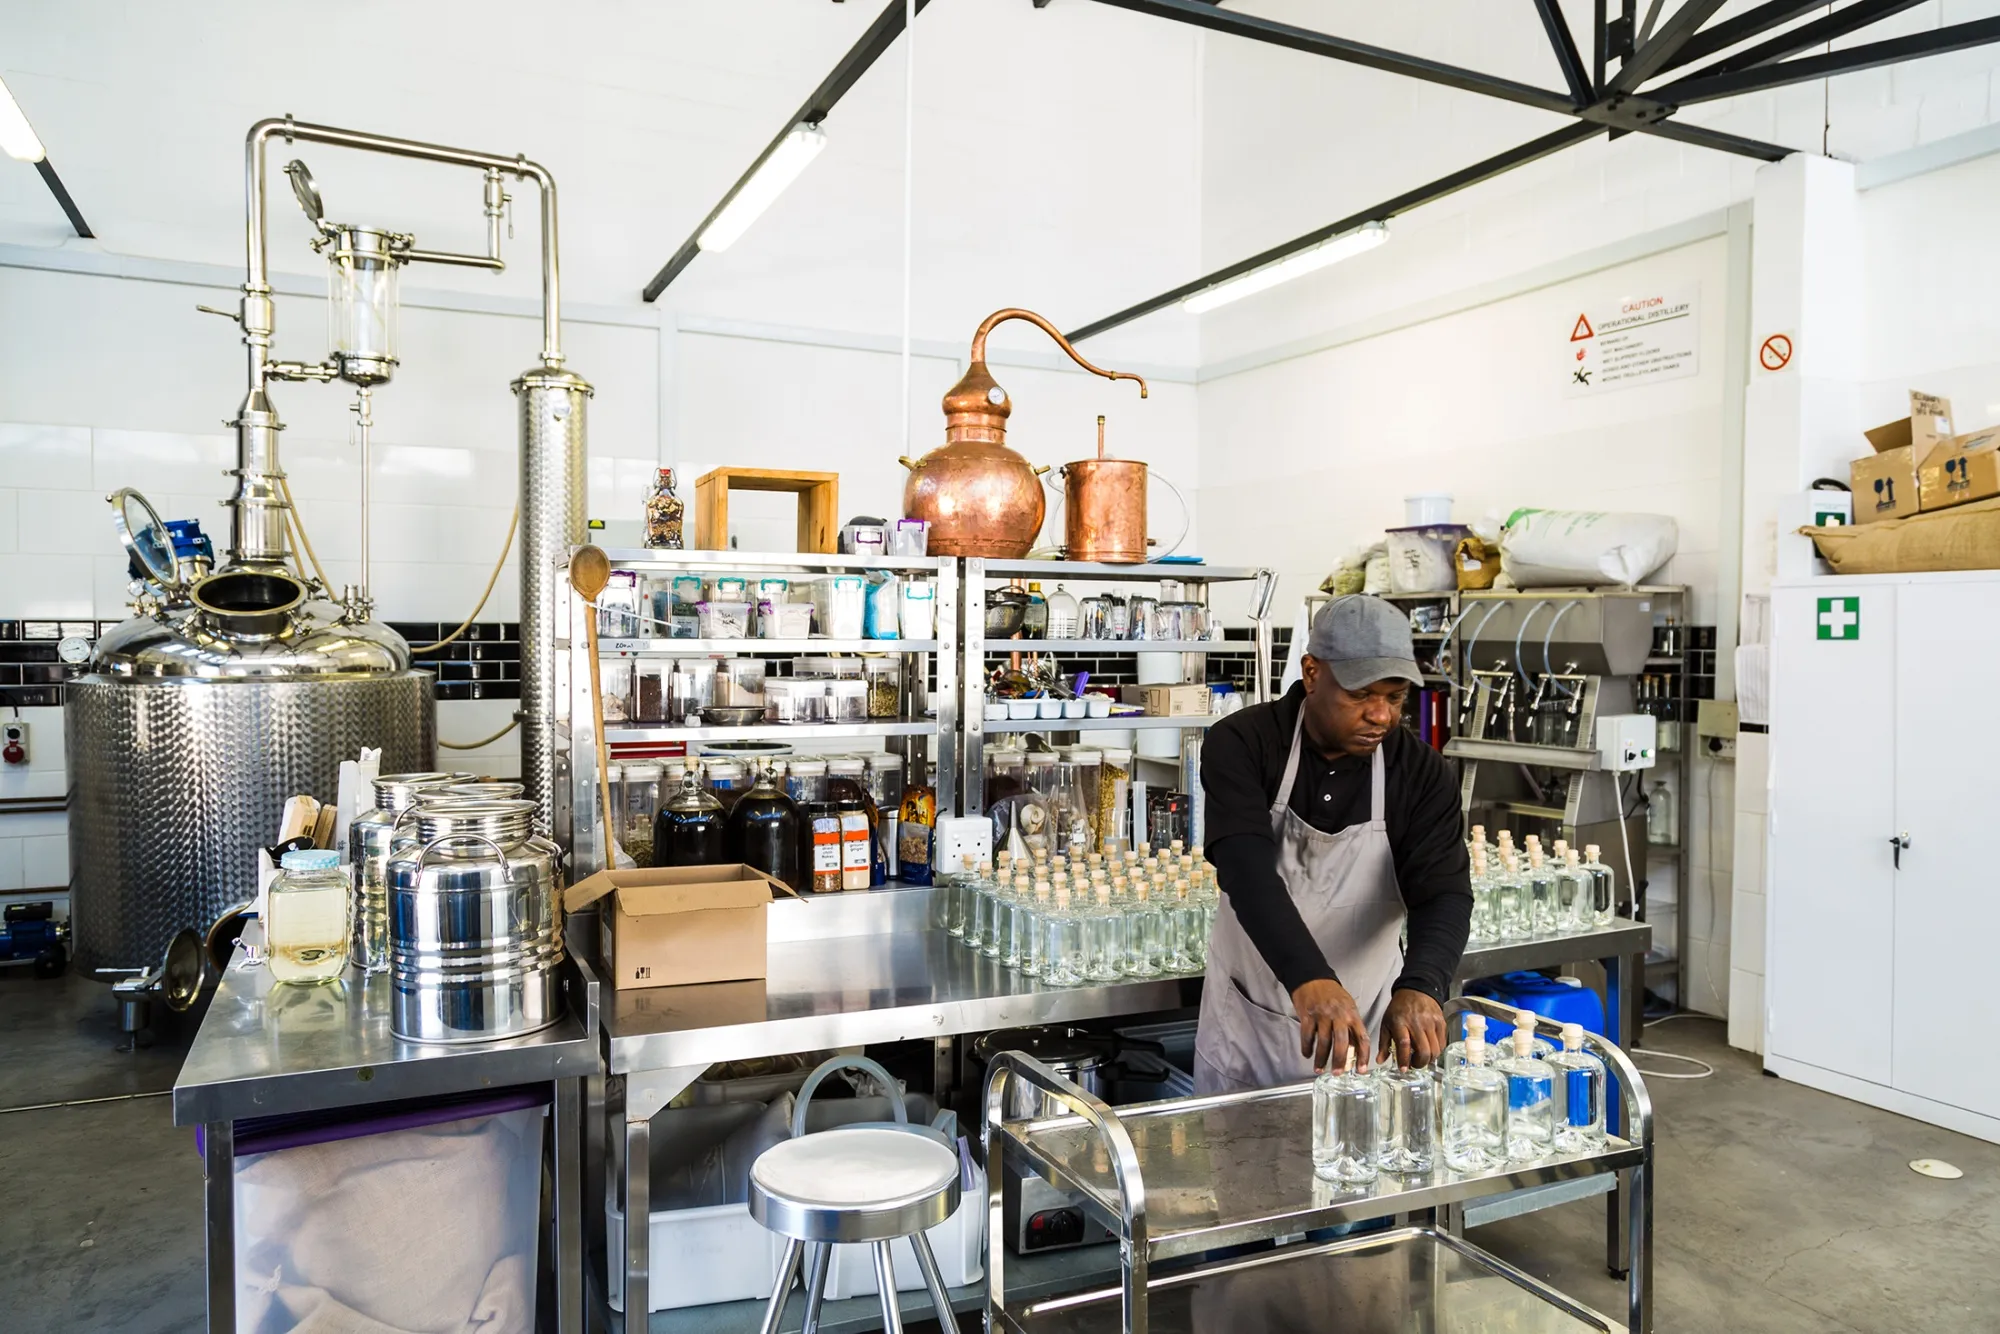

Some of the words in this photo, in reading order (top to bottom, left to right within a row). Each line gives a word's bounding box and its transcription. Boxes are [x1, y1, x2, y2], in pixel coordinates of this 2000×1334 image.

[1622, 296, 1664, 314] CAUTION
[1598, 314, 1645, 331] OPERATIONAL
[1648, 303, 1690, 319] DISTILLERY
